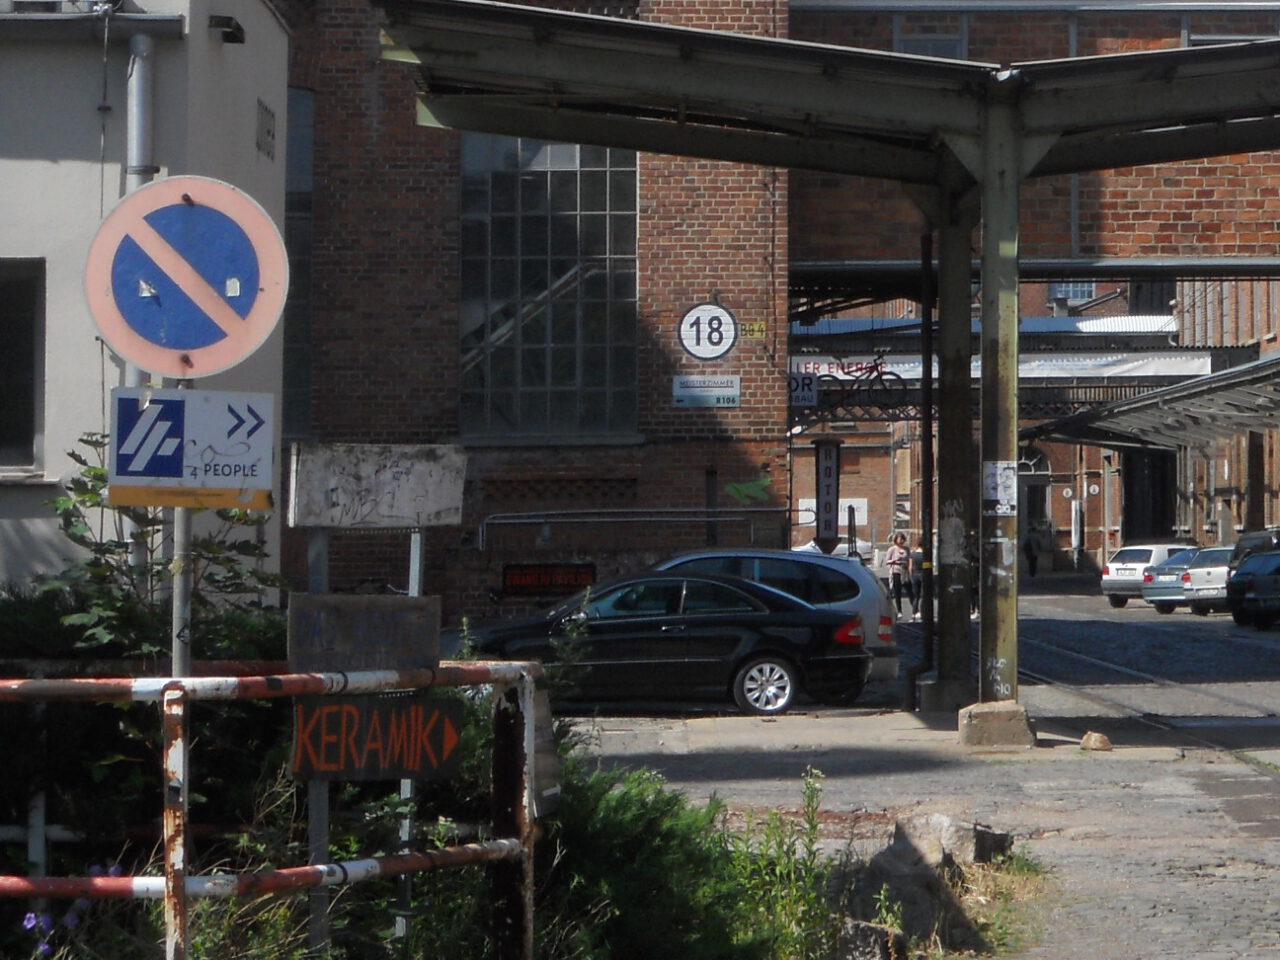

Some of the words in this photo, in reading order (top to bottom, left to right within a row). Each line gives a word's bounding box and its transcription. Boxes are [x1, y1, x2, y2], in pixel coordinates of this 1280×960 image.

[690, 315, 723, 346] 18
[204, 463, 258, 478] PEOPLE
[291, 703, 441, 773] KERAMIK
